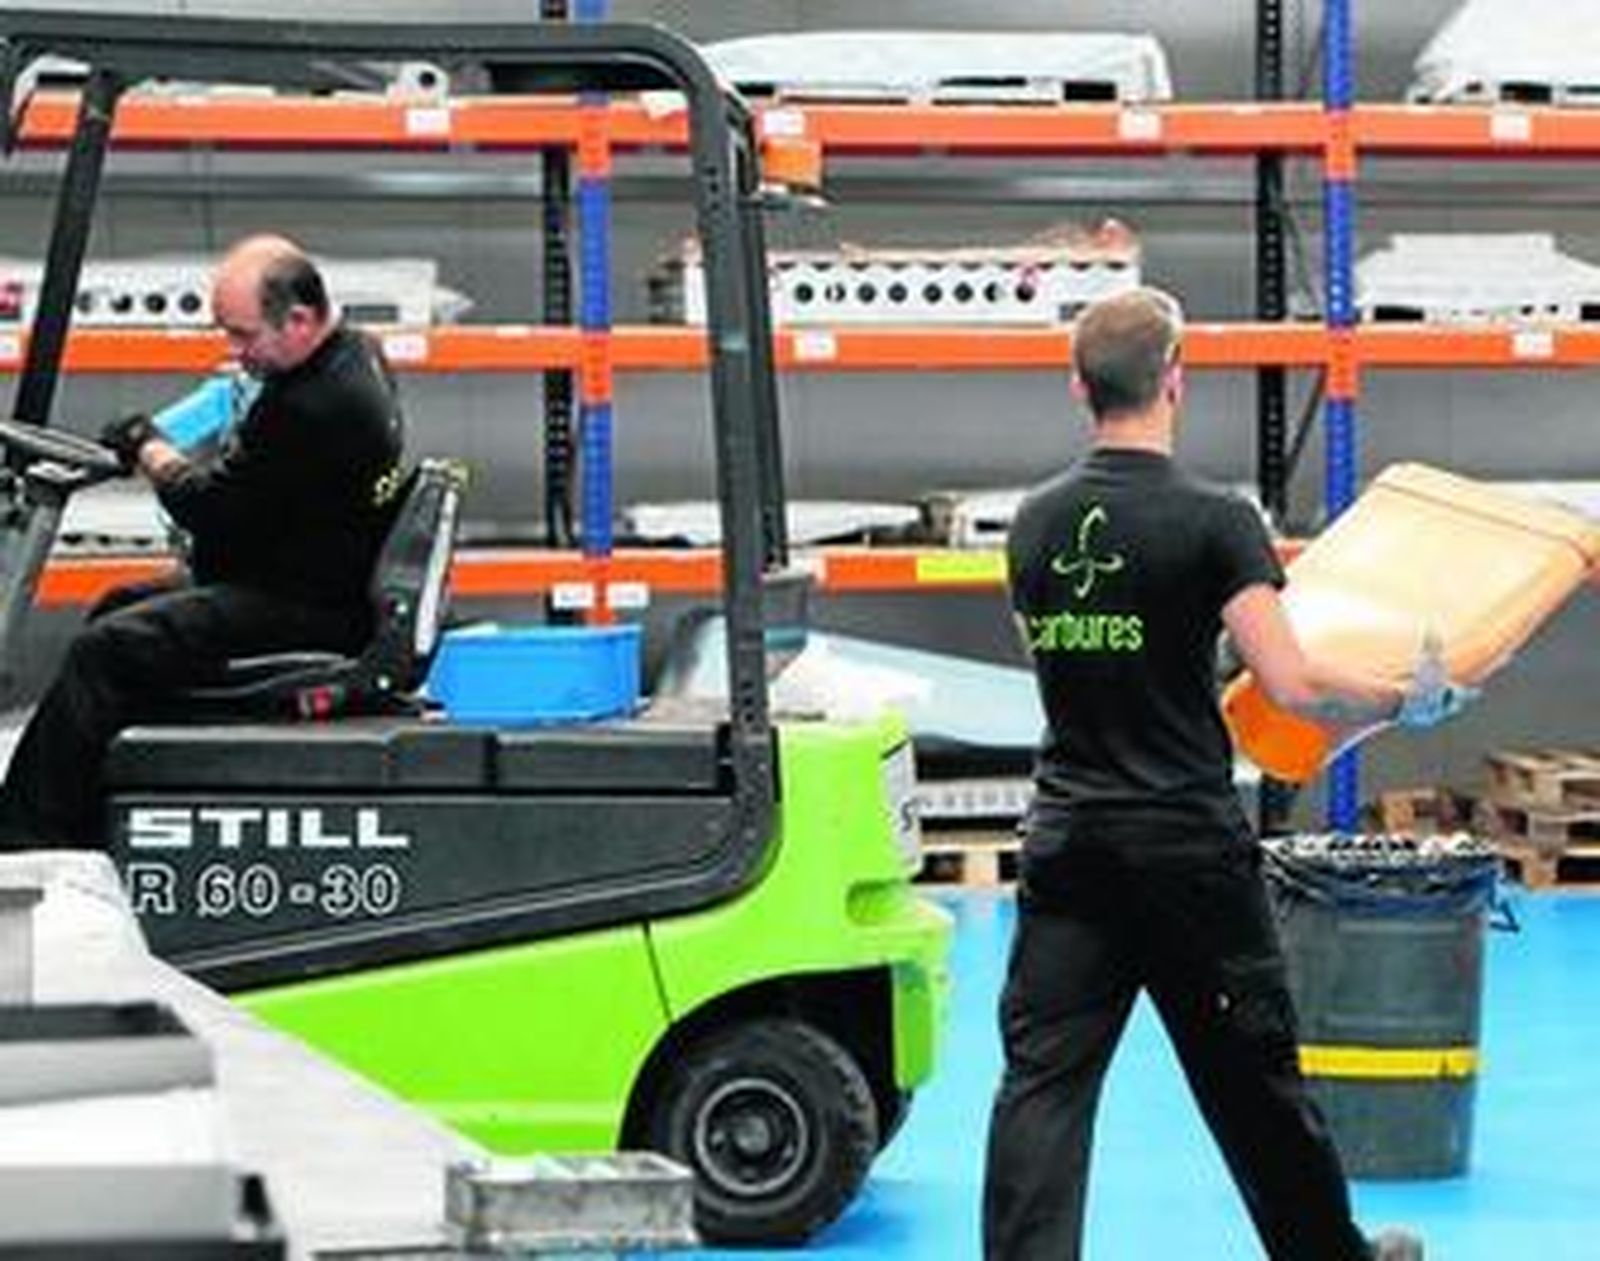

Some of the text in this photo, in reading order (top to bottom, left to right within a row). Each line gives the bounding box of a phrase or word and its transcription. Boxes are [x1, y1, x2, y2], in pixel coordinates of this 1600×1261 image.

[129, 808, 409, 848] STILL
[130, 863, 401, 916] R 60-30
